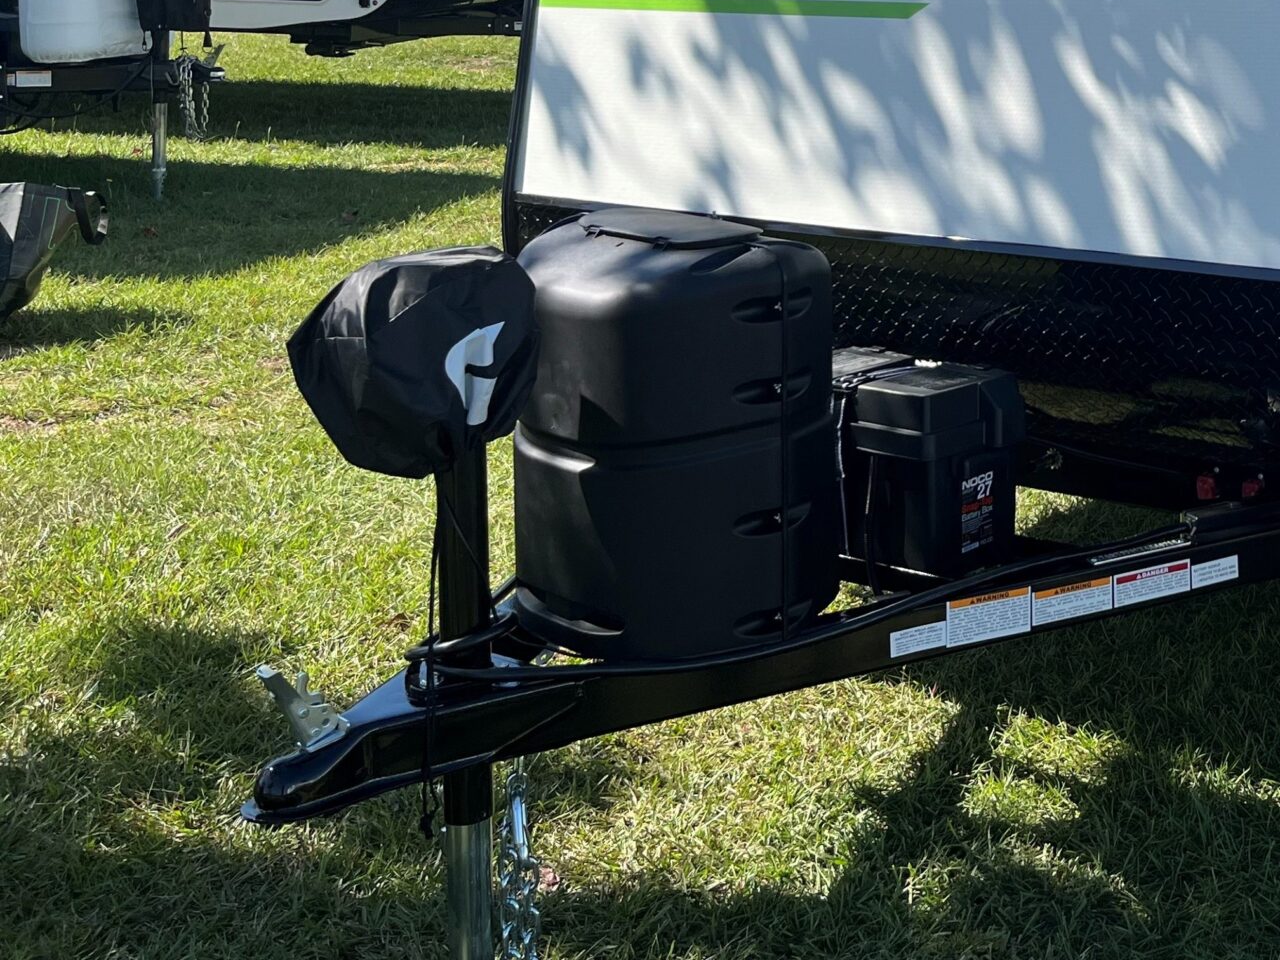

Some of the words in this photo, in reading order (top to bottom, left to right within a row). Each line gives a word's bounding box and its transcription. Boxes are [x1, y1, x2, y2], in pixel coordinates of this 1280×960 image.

[961, 471, 994, 491] NOCO
[977, 480, 993, 500] 27
[1142, 567, 1169, 579] DANGER
[1060, 582, 1092, 594] WARNING
[976, 592, 1010, 605] WARNING
